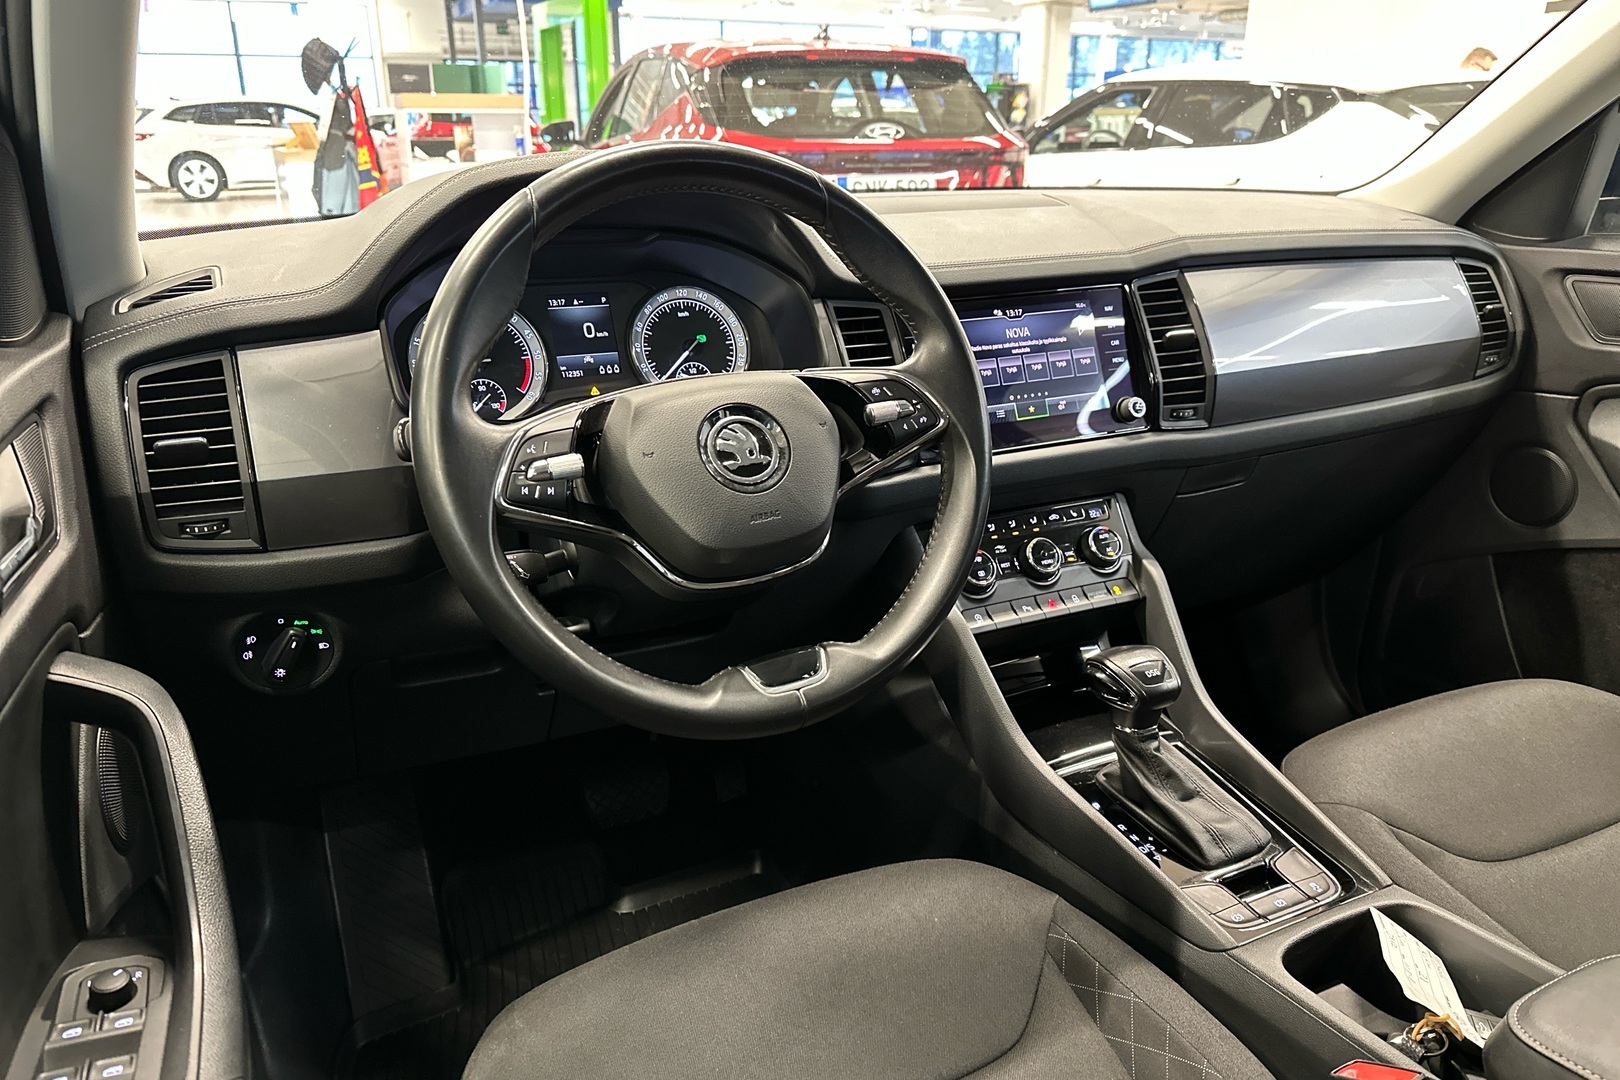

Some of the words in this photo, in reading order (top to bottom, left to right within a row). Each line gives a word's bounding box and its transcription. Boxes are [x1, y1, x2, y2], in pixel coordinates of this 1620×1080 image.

[656, 293, 669, 302] 100
[695, 291, 708, 300] 140
[643, 304, 652, 315] 80
[712, 299, 724, 311] 160
[727, 314, 738, 327] 180
[583, 322, 595, 338] 0
[636, 321, 643, 332] 60
[523, 329, 534, 339] 45
[1006, 327, 1030, 339] NOVA
[736, 333, 745, 347] 200
[635, 342, 641, 352] 40
[533, 350, 542, 360] 50
[641, 363, 648, 372] 20
[535, 371, 542, 381] 55
[561, 370, 584, 378] 112351
[526, 391, 535, 400] 60
[750, 510, 782, 524] AIRBAG
[1145, 668, 1160, 678] DSG
